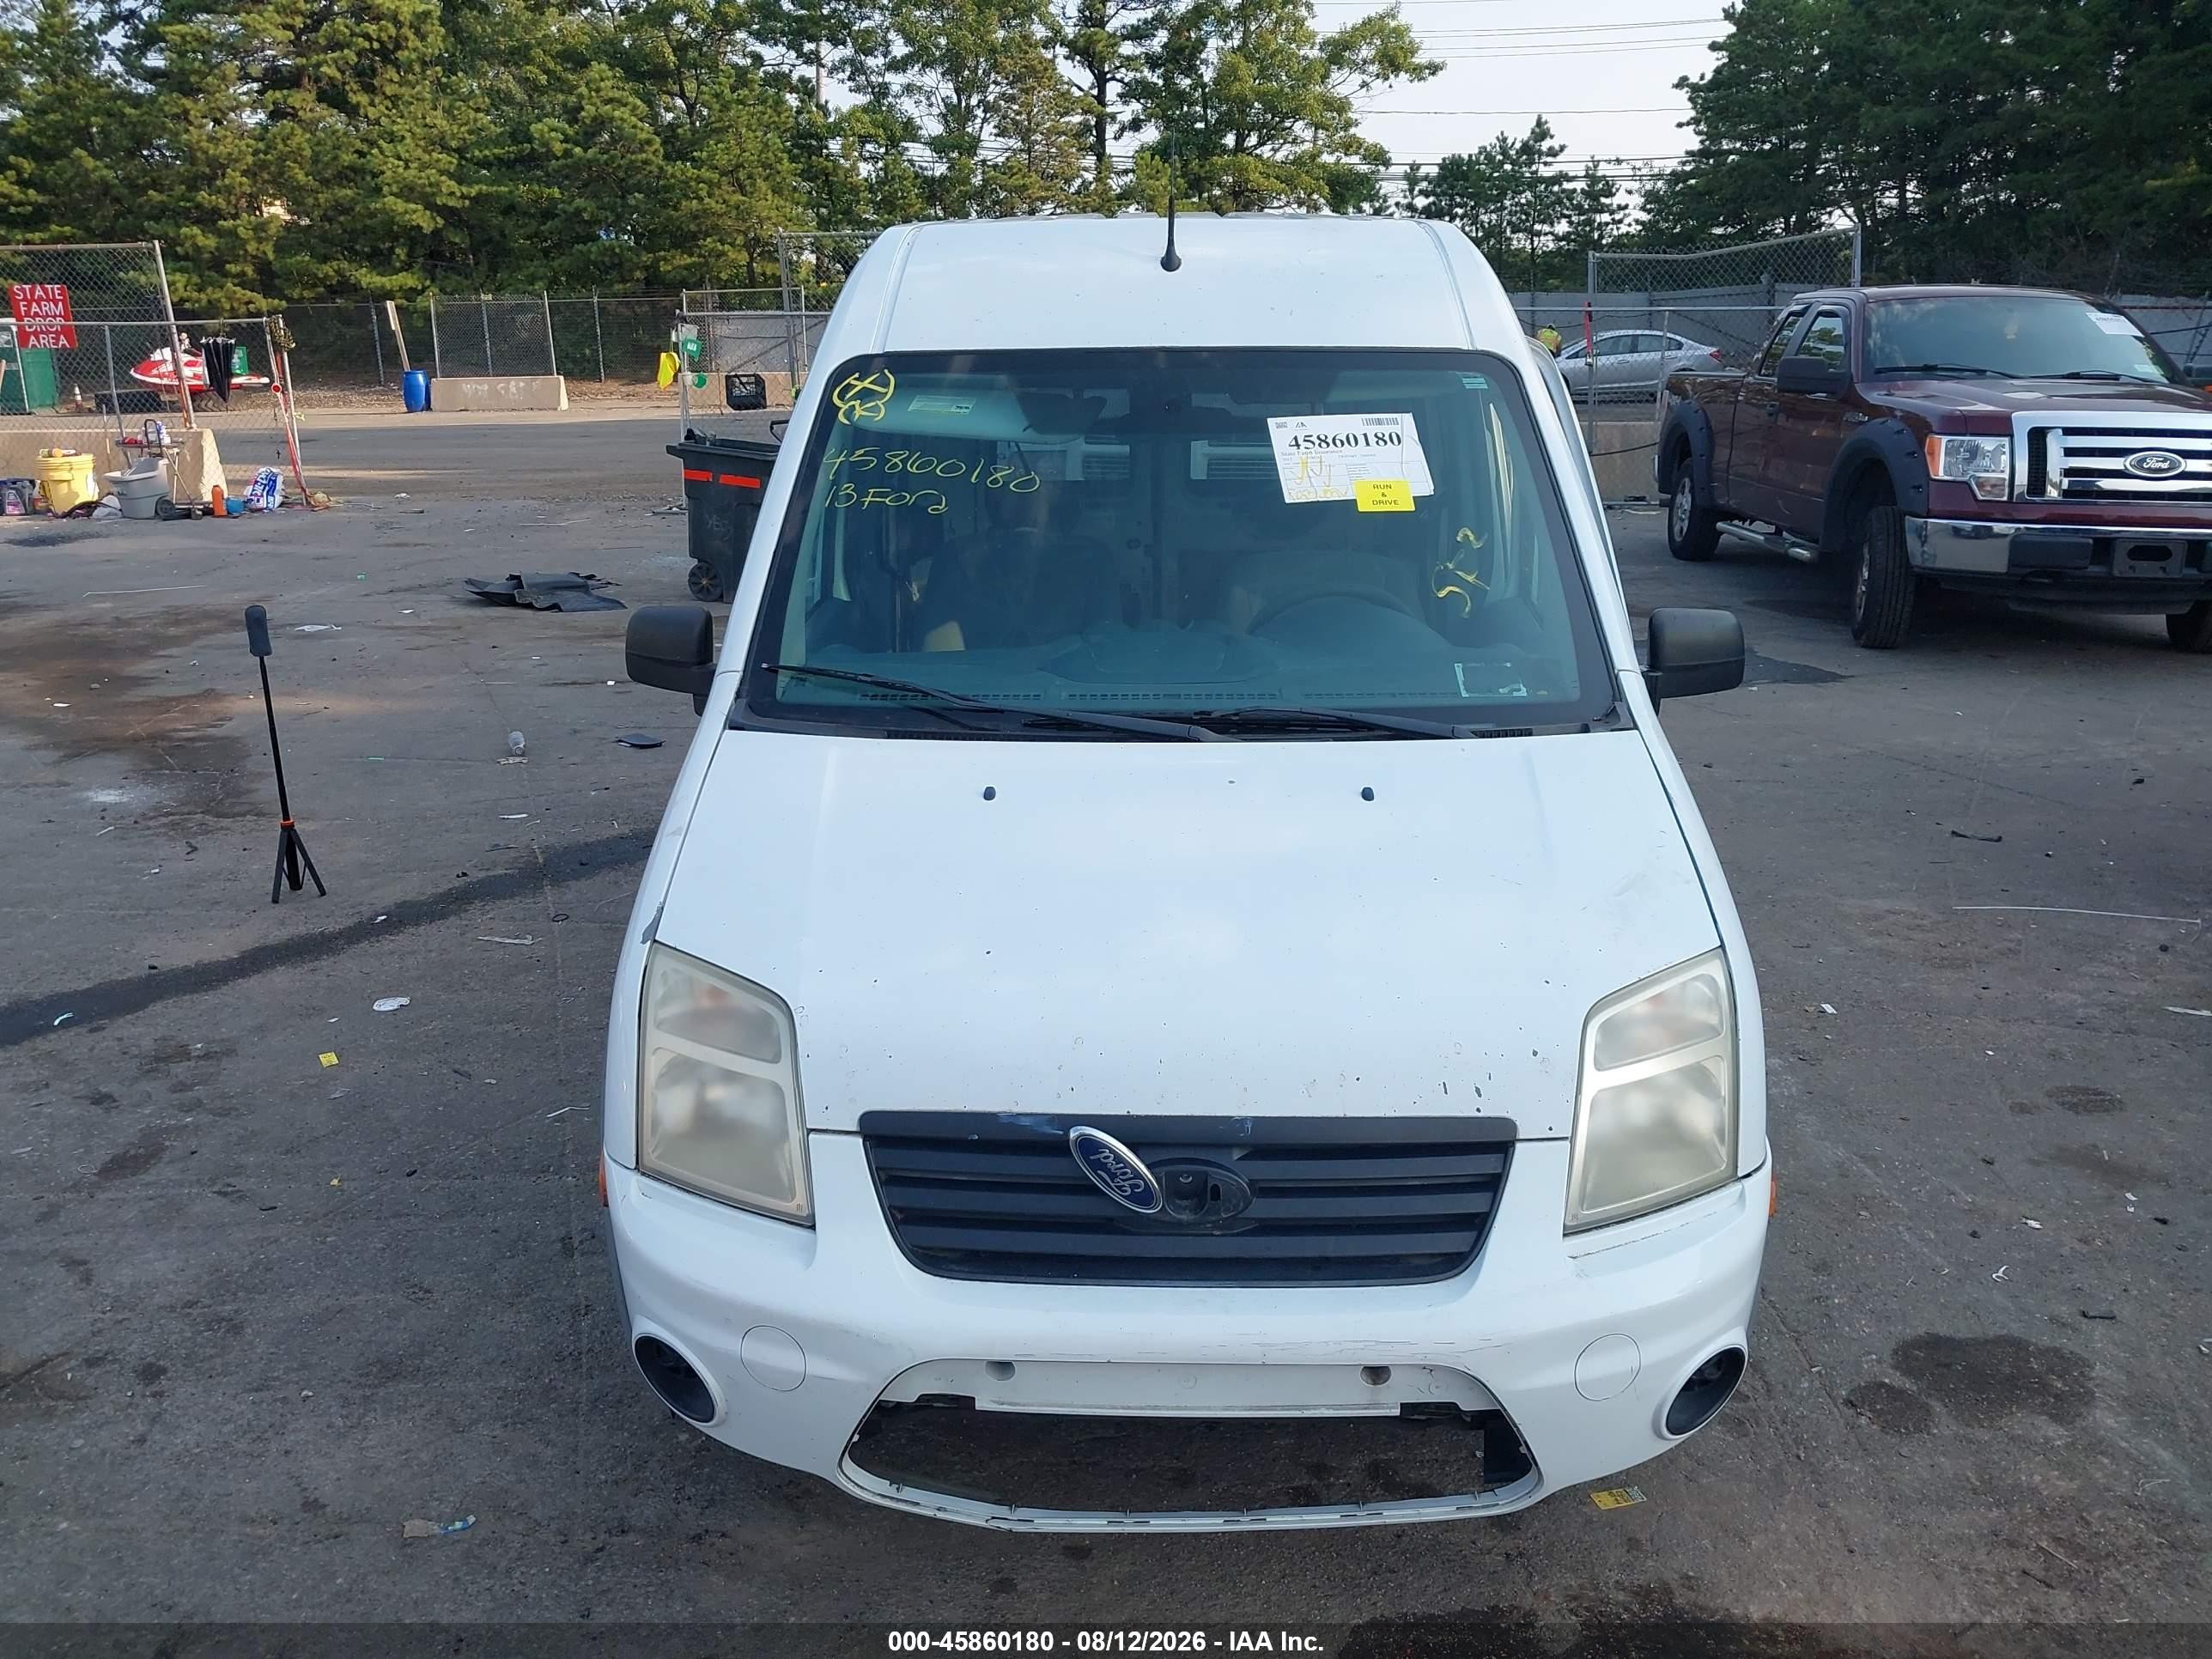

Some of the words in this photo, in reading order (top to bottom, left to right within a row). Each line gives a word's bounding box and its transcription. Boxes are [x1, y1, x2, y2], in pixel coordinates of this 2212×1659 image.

[14, 284, 64, 300] STATE
[20, 301, 64, 316] FARM
[23, 317, 65, 332] DROP
[28, 333, 70, 349] AREA
[1288, 431, 1402, 450] 45860180
[823, 447, 1041, 493] 45860180
[2142, 457, 2171, 469] Ford
[1089, 1148, 1145, 1196] Ford
